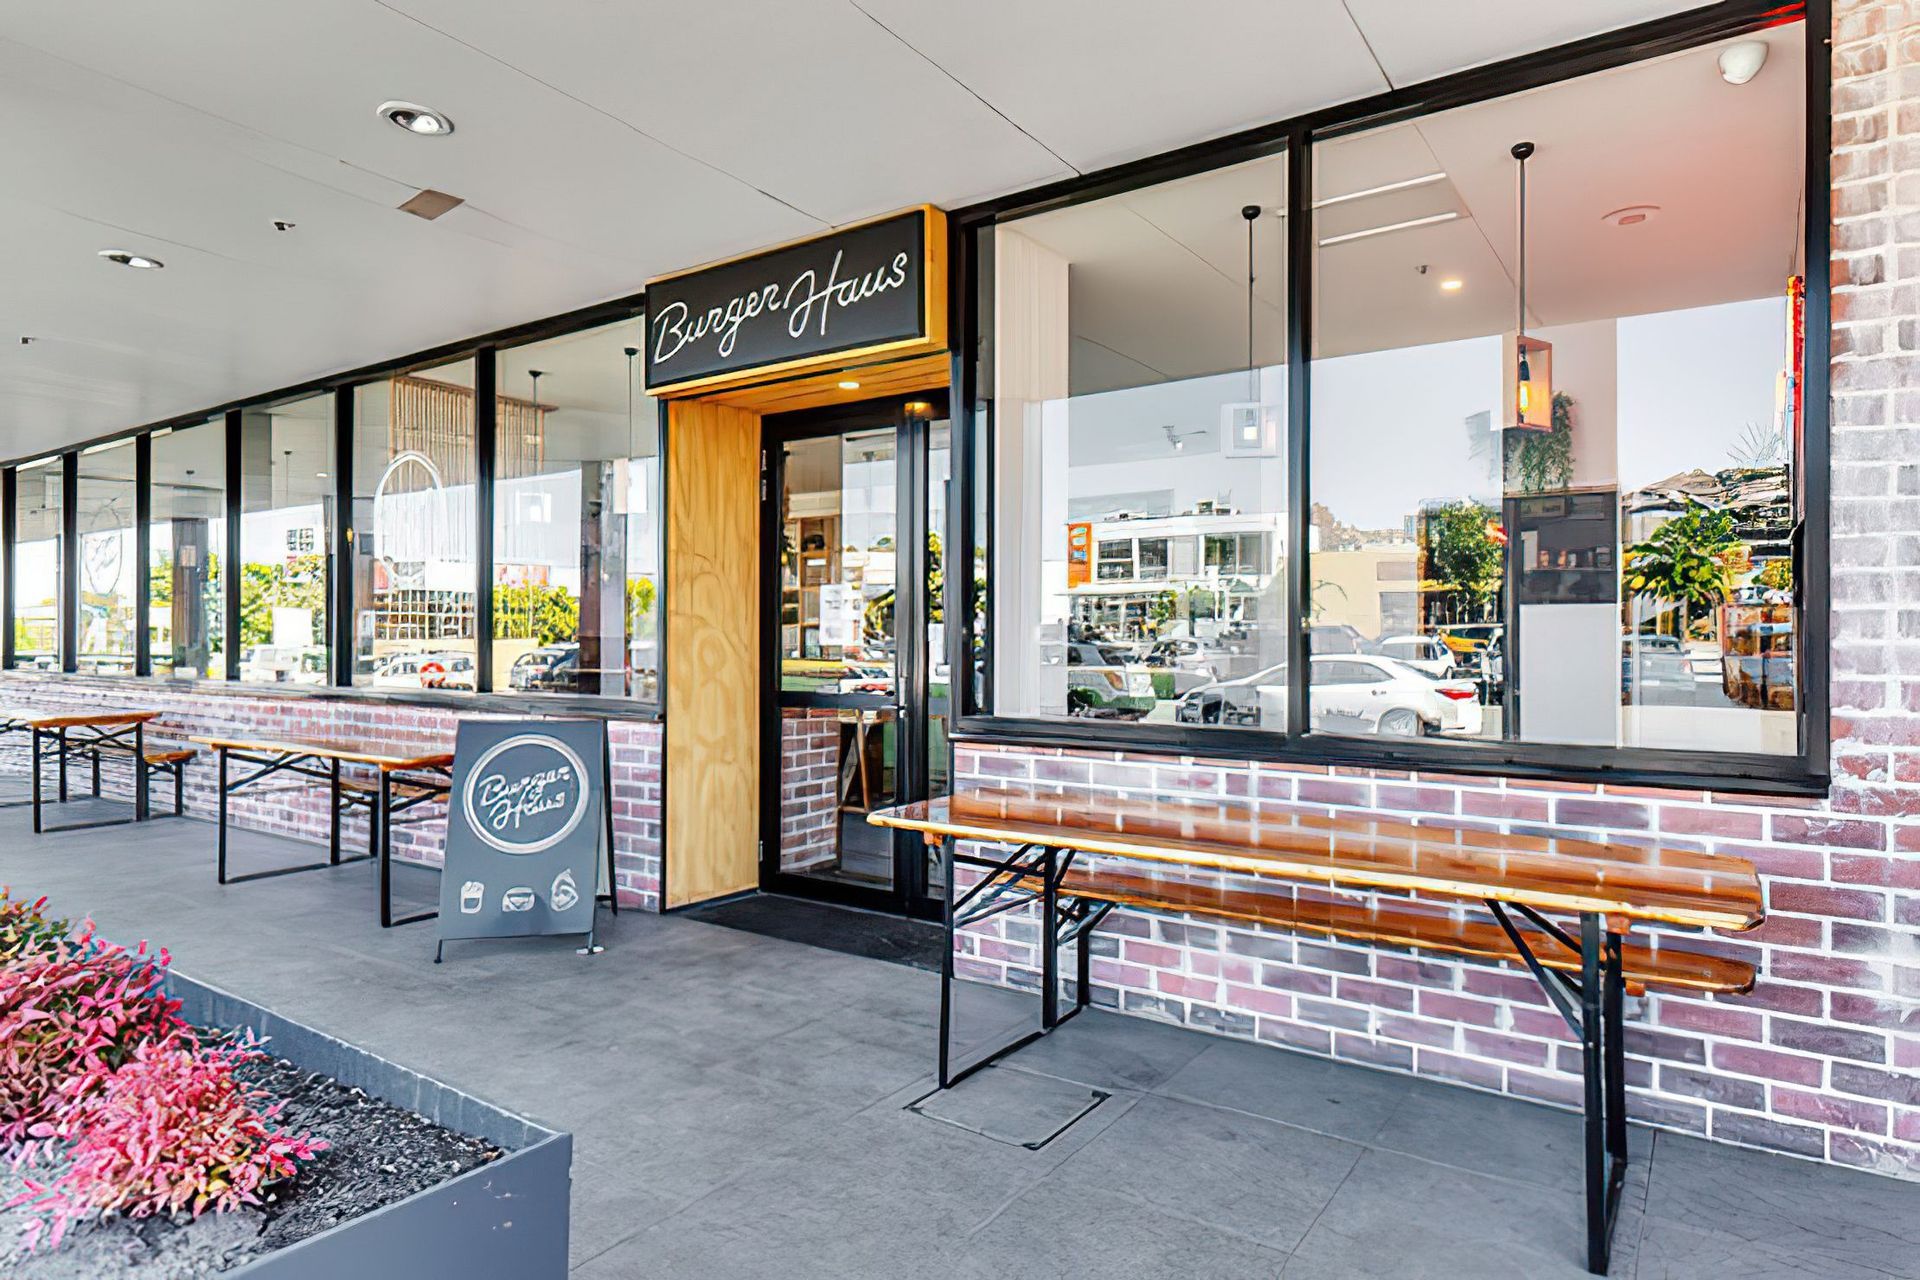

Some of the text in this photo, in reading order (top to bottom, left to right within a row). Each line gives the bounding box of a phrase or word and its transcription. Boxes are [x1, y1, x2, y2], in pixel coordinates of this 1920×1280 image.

[653, 250, 908, 364] Burger Haus
[479, 766, 570, 806] Burger
[489, 785, 565, 830] Haus
